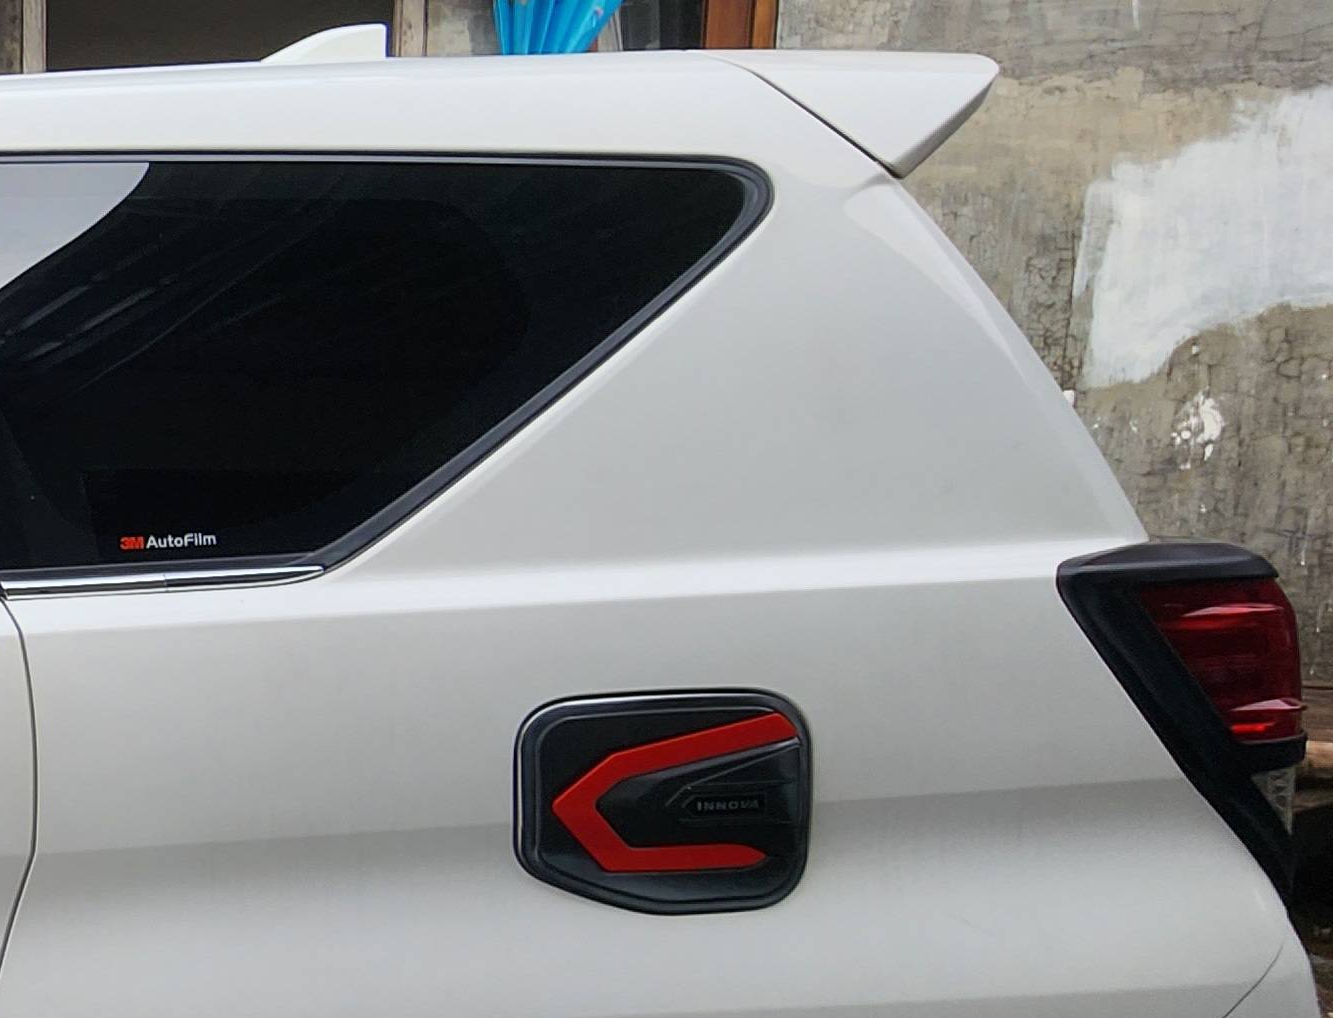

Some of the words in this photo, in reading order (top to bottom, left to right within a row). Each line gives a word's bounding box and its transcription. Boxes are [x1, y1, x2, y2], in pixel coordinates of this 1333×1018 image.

[119, 535, 145, 550] 3M
[146, 532, 217, 549] AutoFilm
[696, 800, 759, 812] INNOVA
